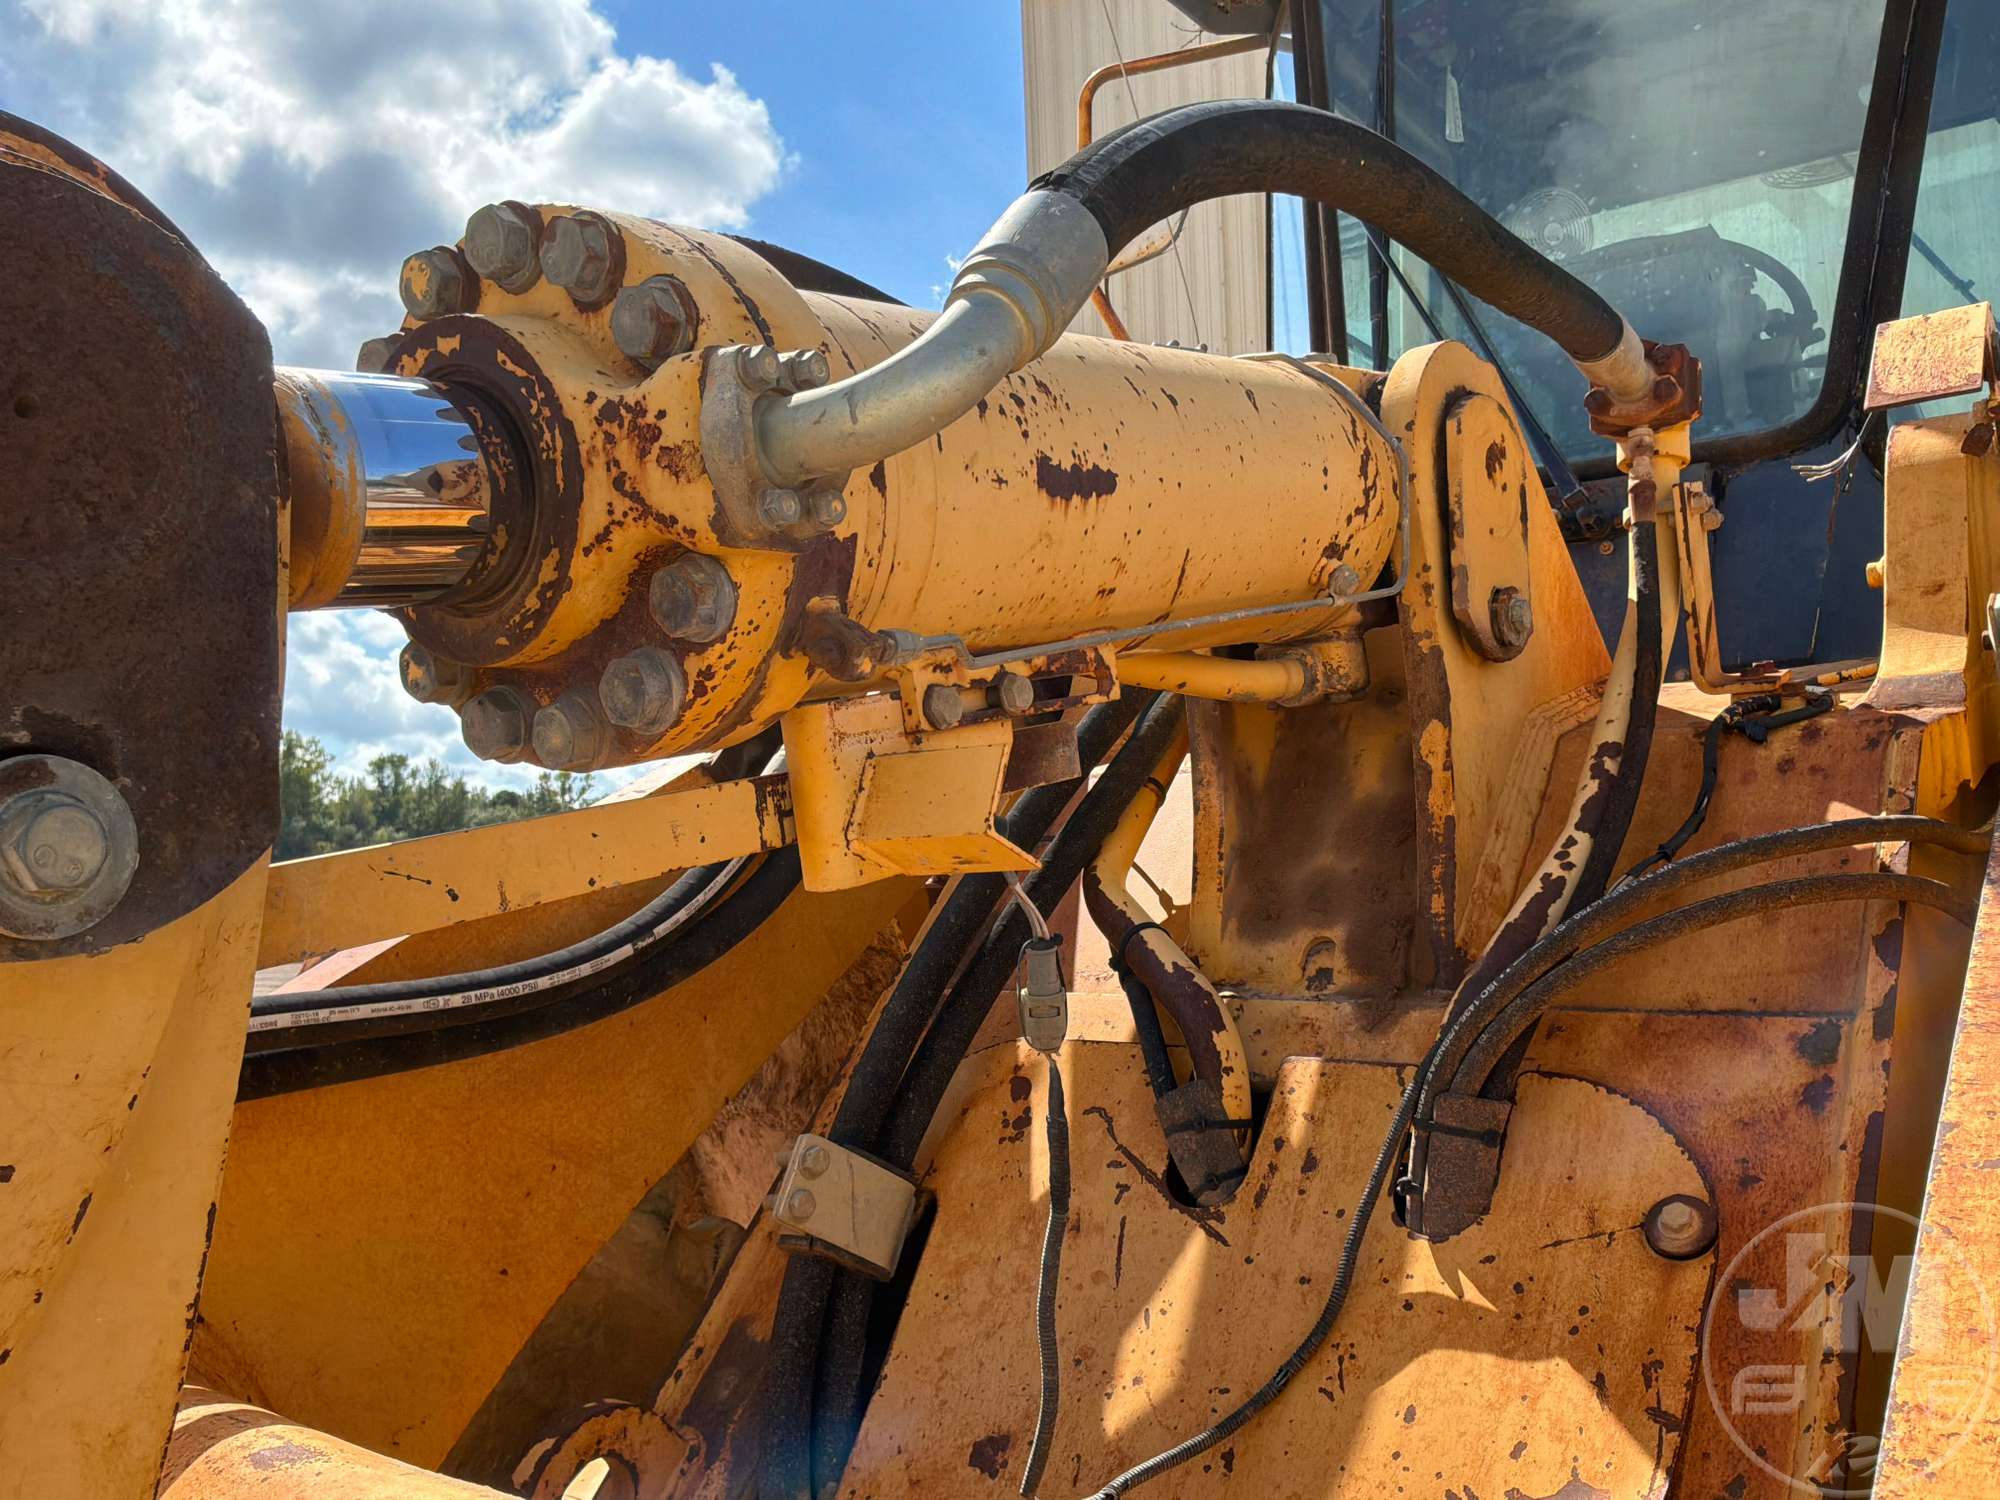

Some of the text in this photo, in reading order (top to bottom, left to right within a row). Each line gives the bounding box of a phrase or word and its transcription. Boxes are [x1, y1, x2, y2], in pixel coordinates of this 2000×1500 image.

[461, 981, 539, 1004] 28 MPa (4000 PSI)
[1480, 979, 1499, 999] ISO
